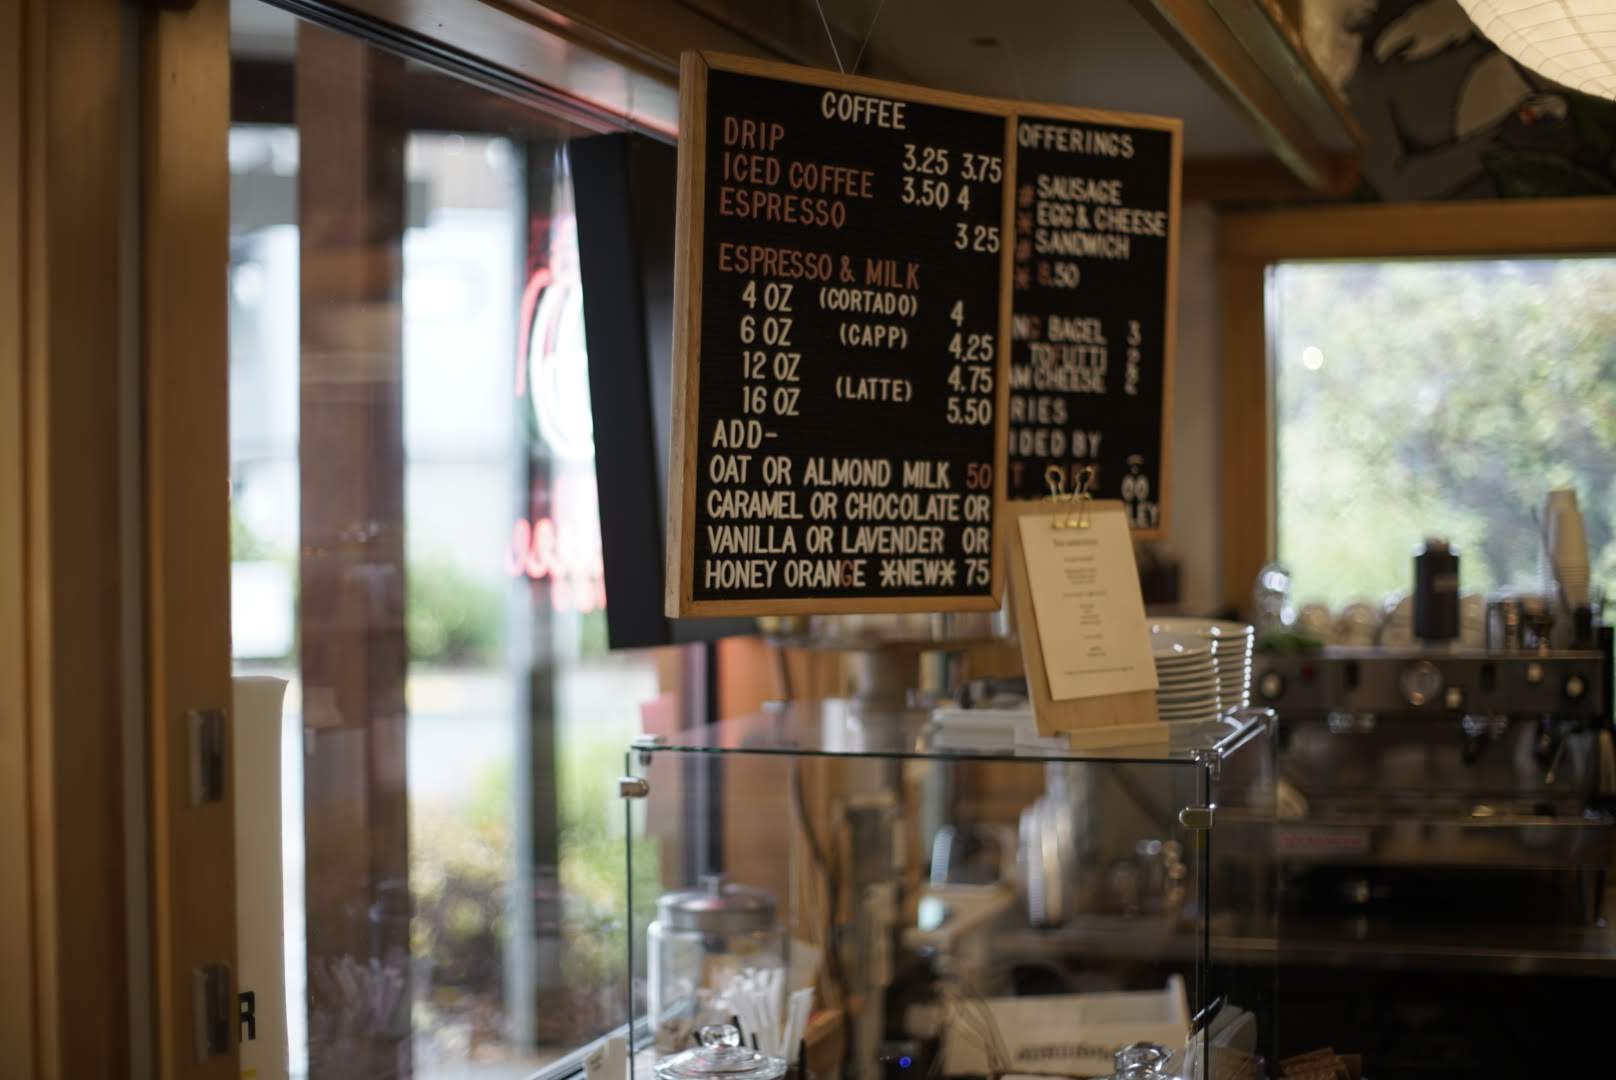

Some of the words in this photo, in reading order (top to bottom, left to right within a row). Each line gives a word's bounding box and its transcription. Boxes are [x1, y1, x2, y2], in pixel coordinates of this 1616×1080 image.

[821, 91, 907, 130] COFFEE
[724, 116, 785, 150] DRIP
[902, 145, 949, 176] 3.25
[961, 152, 1002, 183] 3.75
[1018, 122, 1135, 159] OFFERINGS
[723, 151, 780, 185] ICED
[789, 161, 874, 198] COFFEE
[902, 177, 949, 209] 3.50
[957, 185, 971, 211] 4
[1037, 174, 1123, 205] SAUSAGE
[720, 187, 847, 229] ESPRESSO
[1093, 206, 1167, 237] CHEESE
[1035, 228, 1130, 260] SANDWICH
[719, 243, 832, 282] ESPRESSO
[839, 256, 855, 282] &
[866, 258, 920, 290] MILK
[742, 281, 756, 309] 4
[764, 283, 793, 312] OZ
[819, 287, 918, 317] (CORTADO)
[951, 301, 964, 327] 4
[740, 316, 754, 344] 6
[763, 317, 792, 347] OZ
[839, 323, 908, 349] (CAPP)
[948, 333, 994, 362] 4.25
[743, 351, 766, 381] 12
[773, 353, 800, 382] OZ
[947, 366, 993, 394] 4.75
[835, 376, 912, 402] (LATTE)
[743, 386, 766, 415] 16
[773, 387, 800, 416] OZ
[946, 399, 992, 426] 5.50
[712, 418, 778, 449] ADD-
[709, 454, 752, 484] OAT
[762, 456, 792, 486] OR
[803, 457, 891, 487] ALMOND
[903, 460, 949, 489] MILK
[966, 463, 992, 490] 50
[707, 490, 803, 519] CARAMEL
[810, 491, 837, 520] OR
[845, 492, 959, 521] CHOCOLATE
[964, 494, 990, 522] OR
[707, 525, 797, 554] VANILLA
[806, 525, 833, 554] OR
[841, 526, 944, 554] LAVENDER
[962, 526, 989, 554] OR
[705, 559, 777, 589] HONEY
[784, 559, 866, 588] ORANGE
[965, 558, 990, 587] 75
